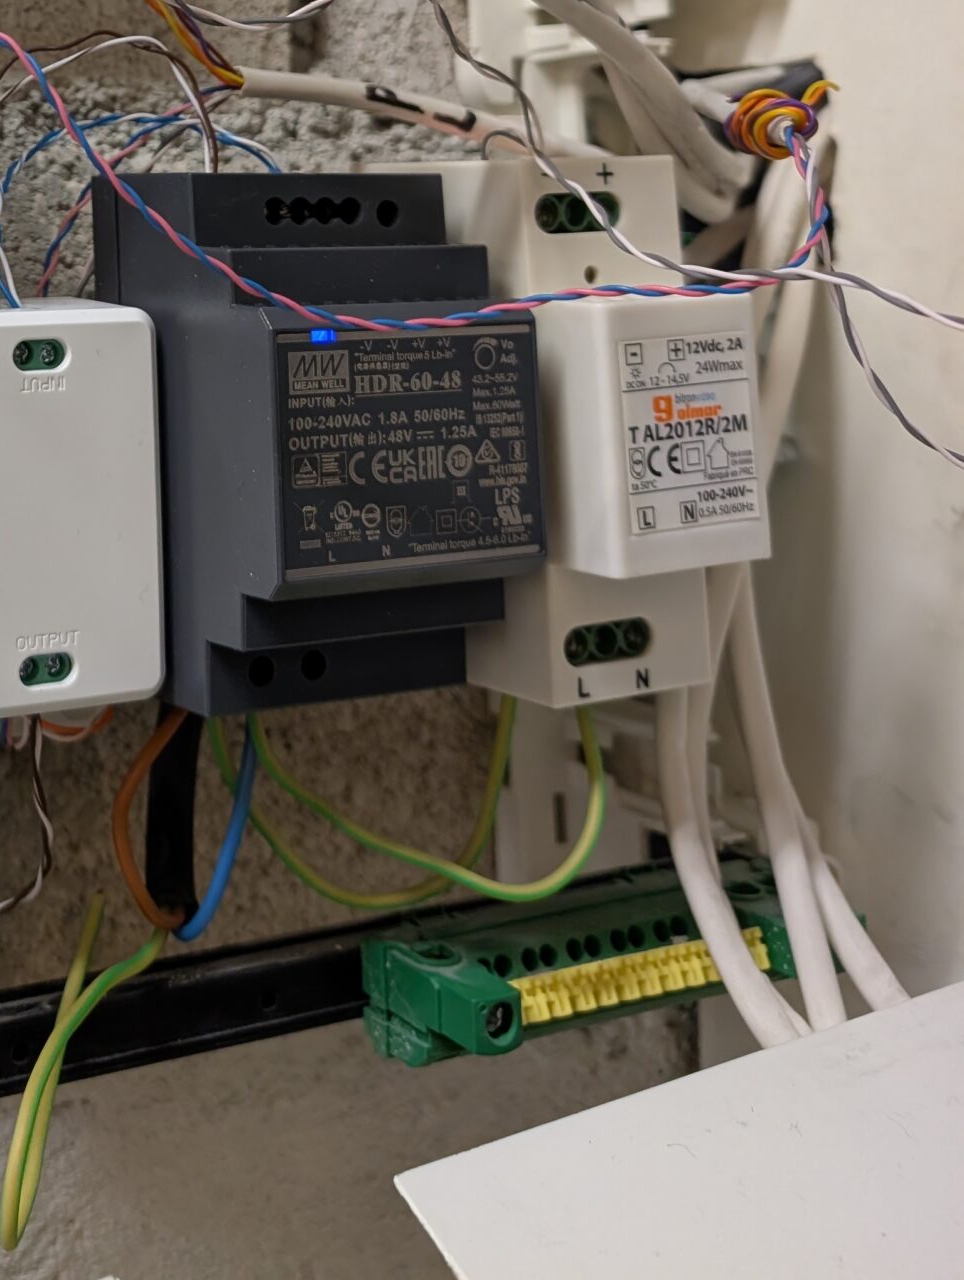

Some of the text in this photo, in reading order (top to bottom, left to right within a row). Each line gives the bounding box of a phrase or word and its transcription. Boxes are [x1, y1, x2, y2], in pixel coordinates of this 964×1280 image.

[500, 338, 514, 350] Vo
[727, 337, 744, 351] 2A
[695, 360, 744, 375] 24Wmax
[293, 378, 345, 391] MEAN WELL
[354, 370, 462, 394] HDR-60-48
[288, 407, 466, 431] 100-240VAC 1.8A 50/60Hz
[440, 425, 478, 439] 1.25A
[495, 486, 521, 505] LPS
[642, 503, 695, 527] L N
[719, 501, 755, 516] 50/60Hz
[329, 544, 391, 562] L N
[16, 629, 80, 651] OUTPUT
[577, 667, 650, 698] L N
